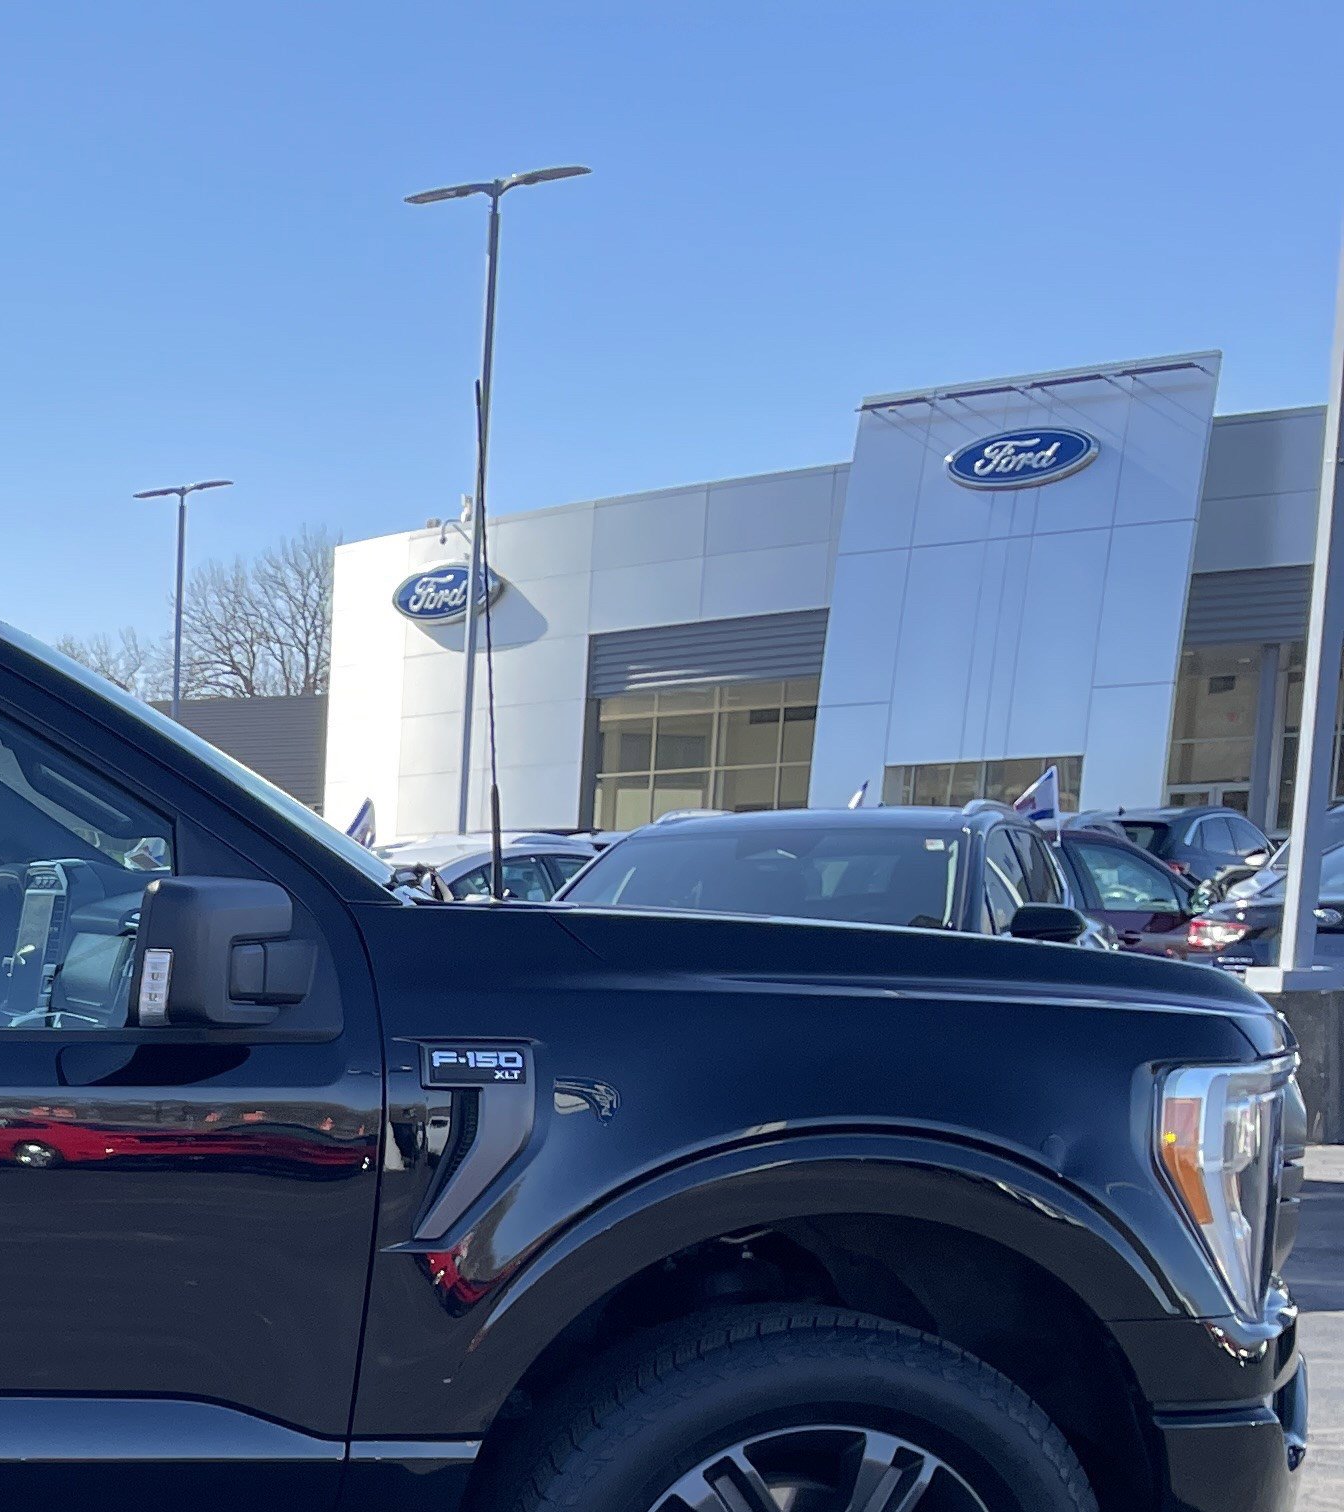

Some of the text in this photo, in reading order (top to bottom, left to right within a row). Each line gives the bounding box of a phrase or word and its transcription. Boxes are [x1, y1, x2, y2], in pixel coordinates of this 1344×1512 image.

[973, 437, 1061, 477] Ford
[408, 574, 468, 612] Ford
[432, 1050, 523, 1068] F-150
[493, 1069, 521, 1080] XLT
